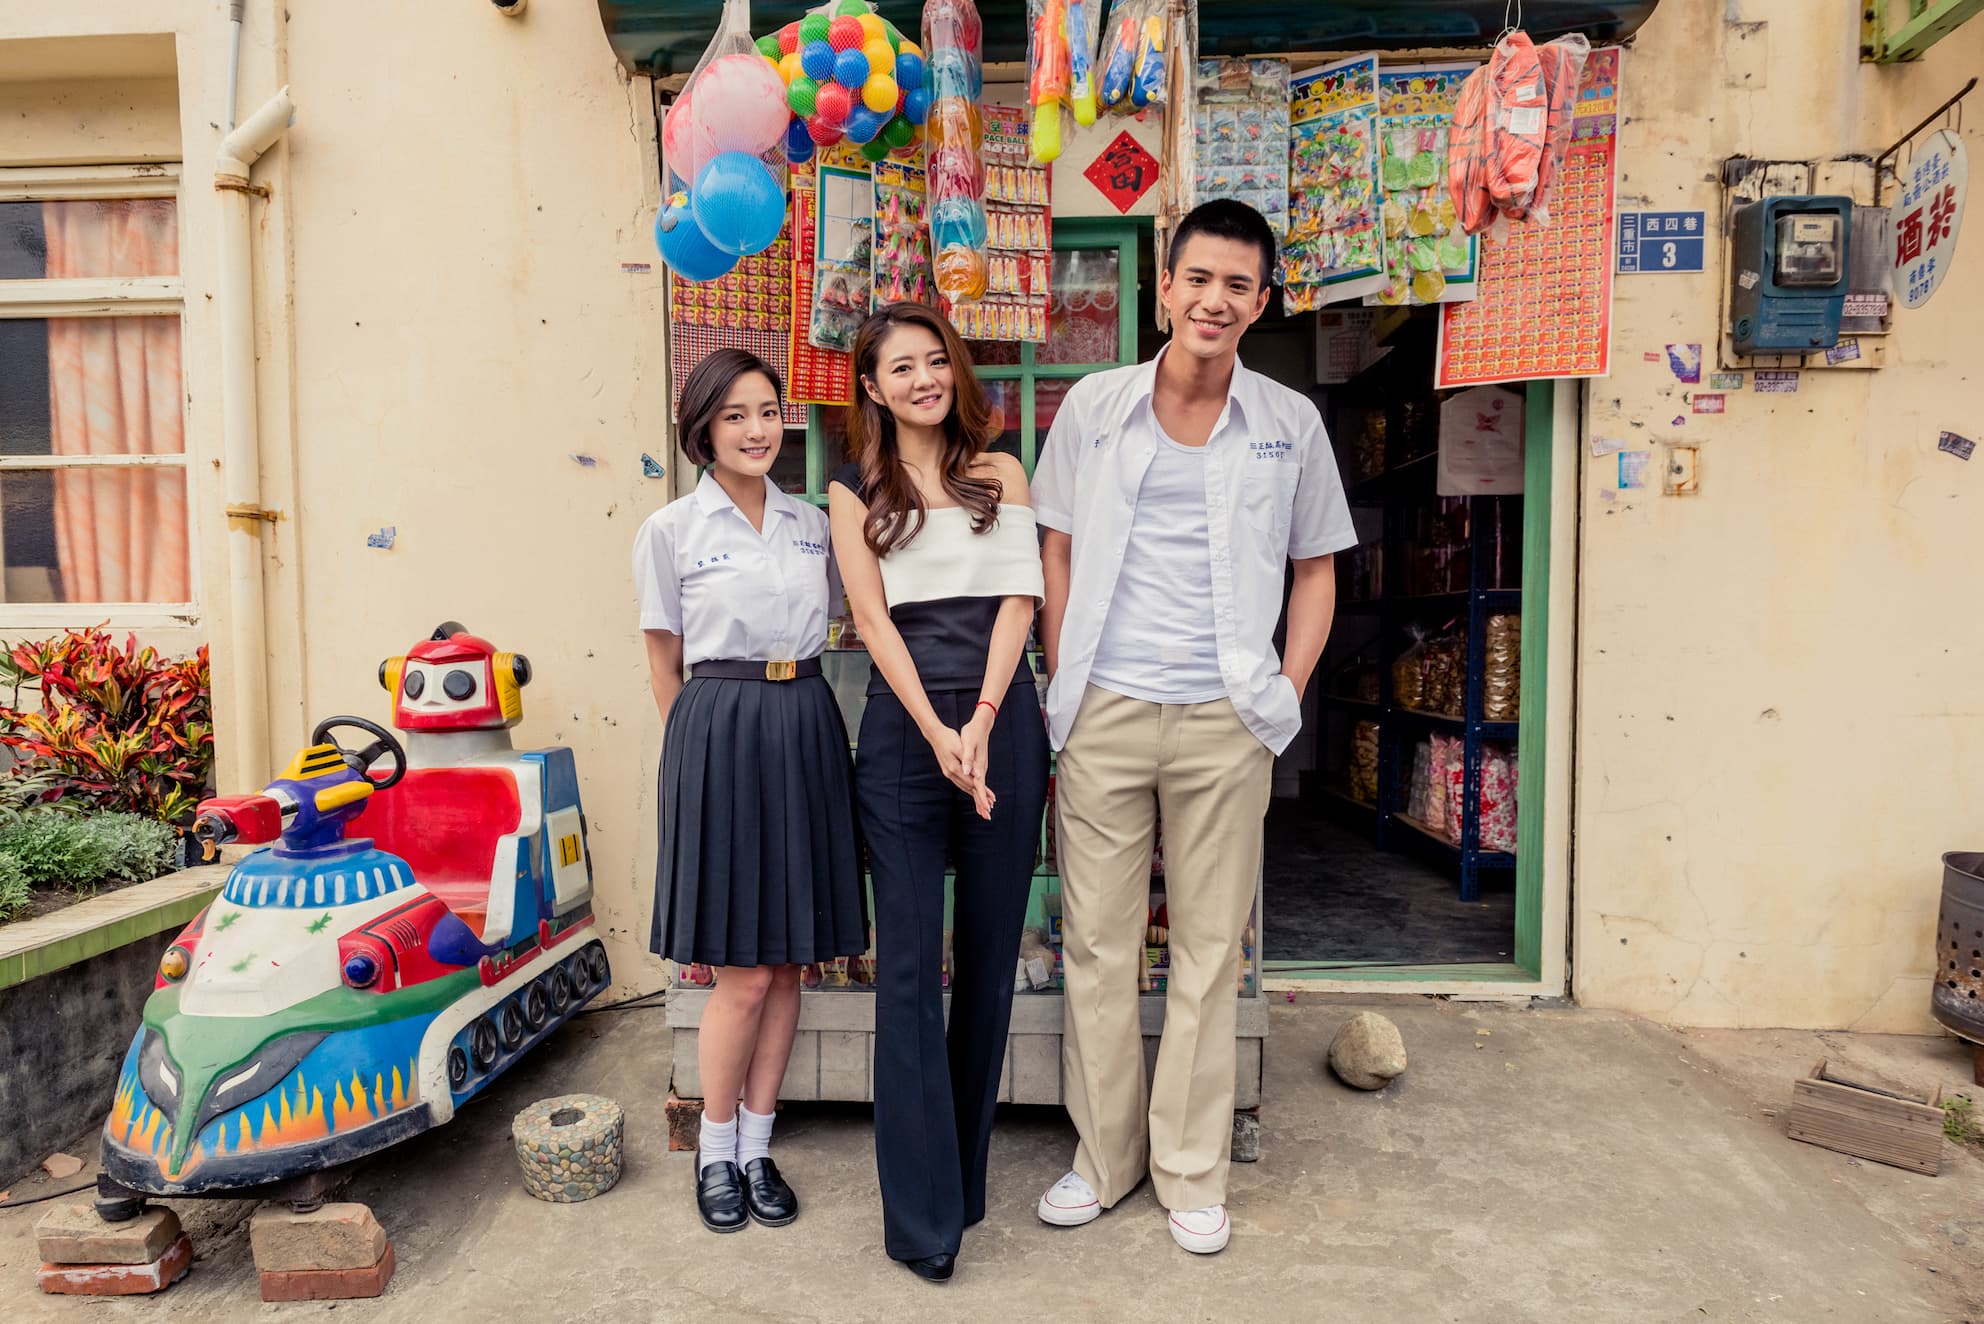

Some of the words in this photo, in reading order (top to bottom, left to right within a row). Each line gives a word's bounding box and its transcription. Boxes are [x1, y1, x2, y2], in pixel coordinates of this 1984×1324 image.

[1297, 73, 1345, 100] TOYS
[1396, 76, 1447, 96] TOYS
[983, 133, 1004, 143] PACE
[1007, 136, 1027, 145] BALL
[1105, 141, 1143, 193] 富
[1622, 215, 1636, 253] 三重市
[1646, 216, 1697, 231] 西四巷
[1662, 242, 1676, 268] 3
